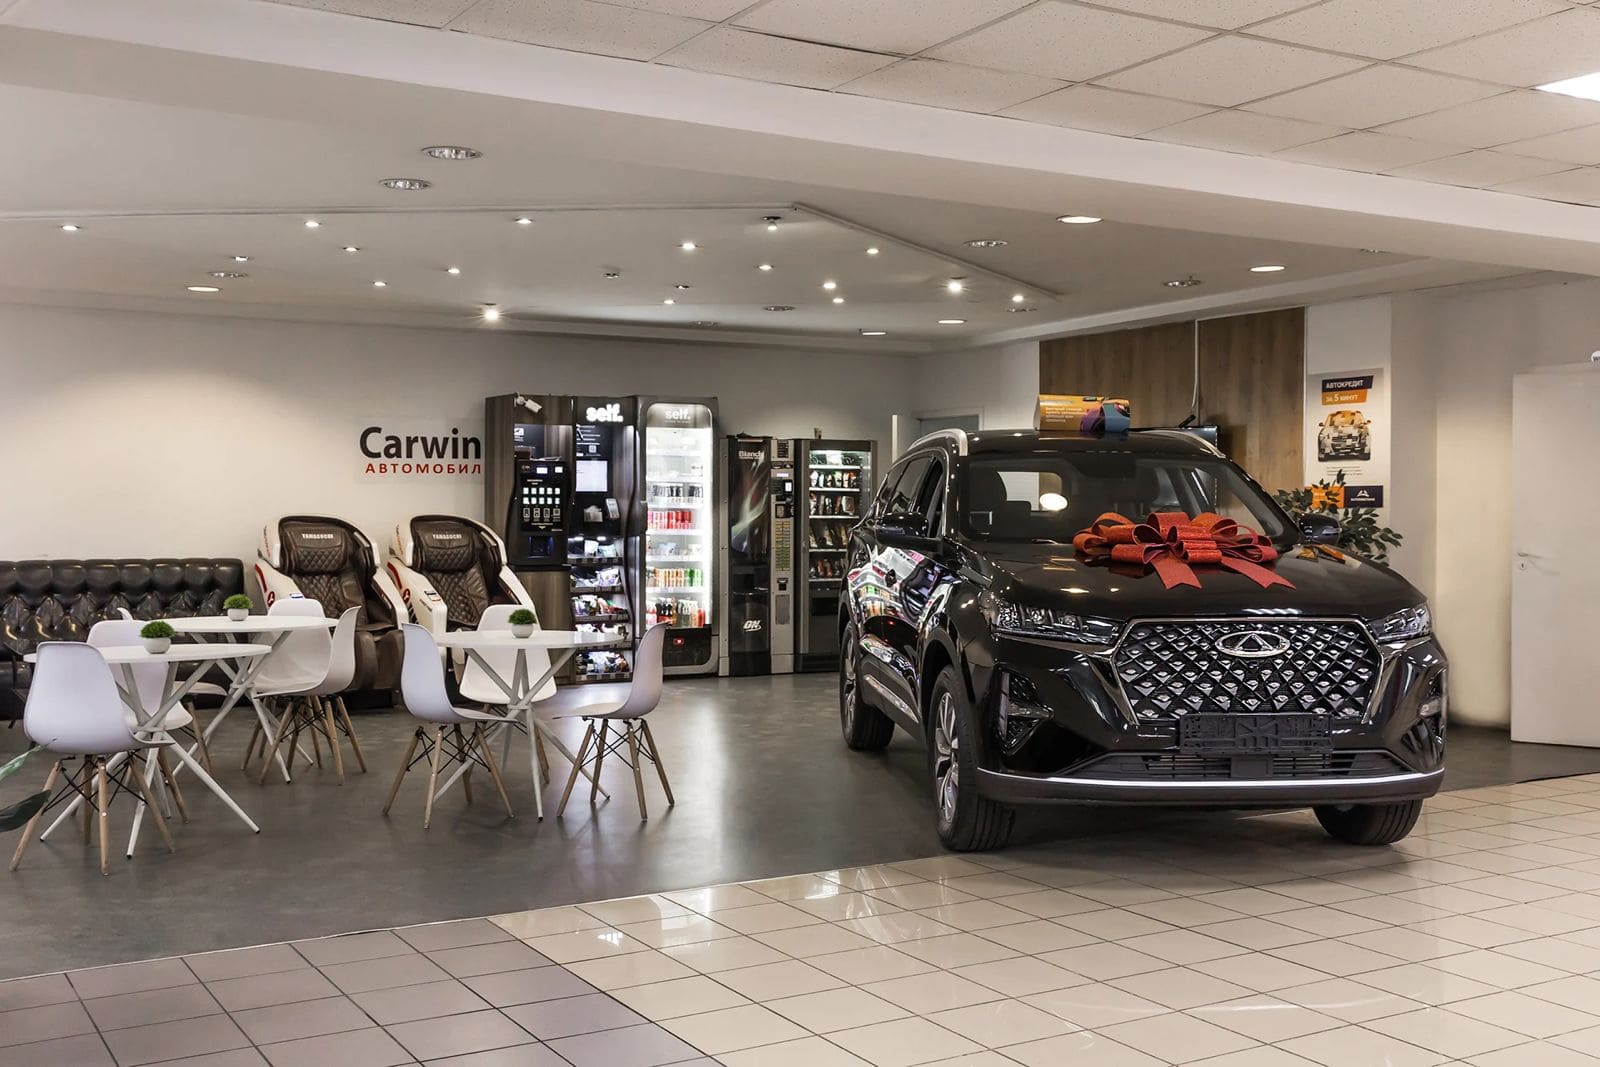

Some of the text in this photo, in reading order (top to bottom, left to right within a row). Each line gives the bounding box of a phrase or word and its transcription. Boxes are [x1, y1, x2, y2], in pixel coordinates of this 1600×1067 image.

[1326, 379, 1364, 389] АВТОКРЕДИТ
[1334, 394, 1340, 402] 5
[359, 426, 482, 459] Carwin
[365, 463, 481, 475] АВТОМОБИЛ
